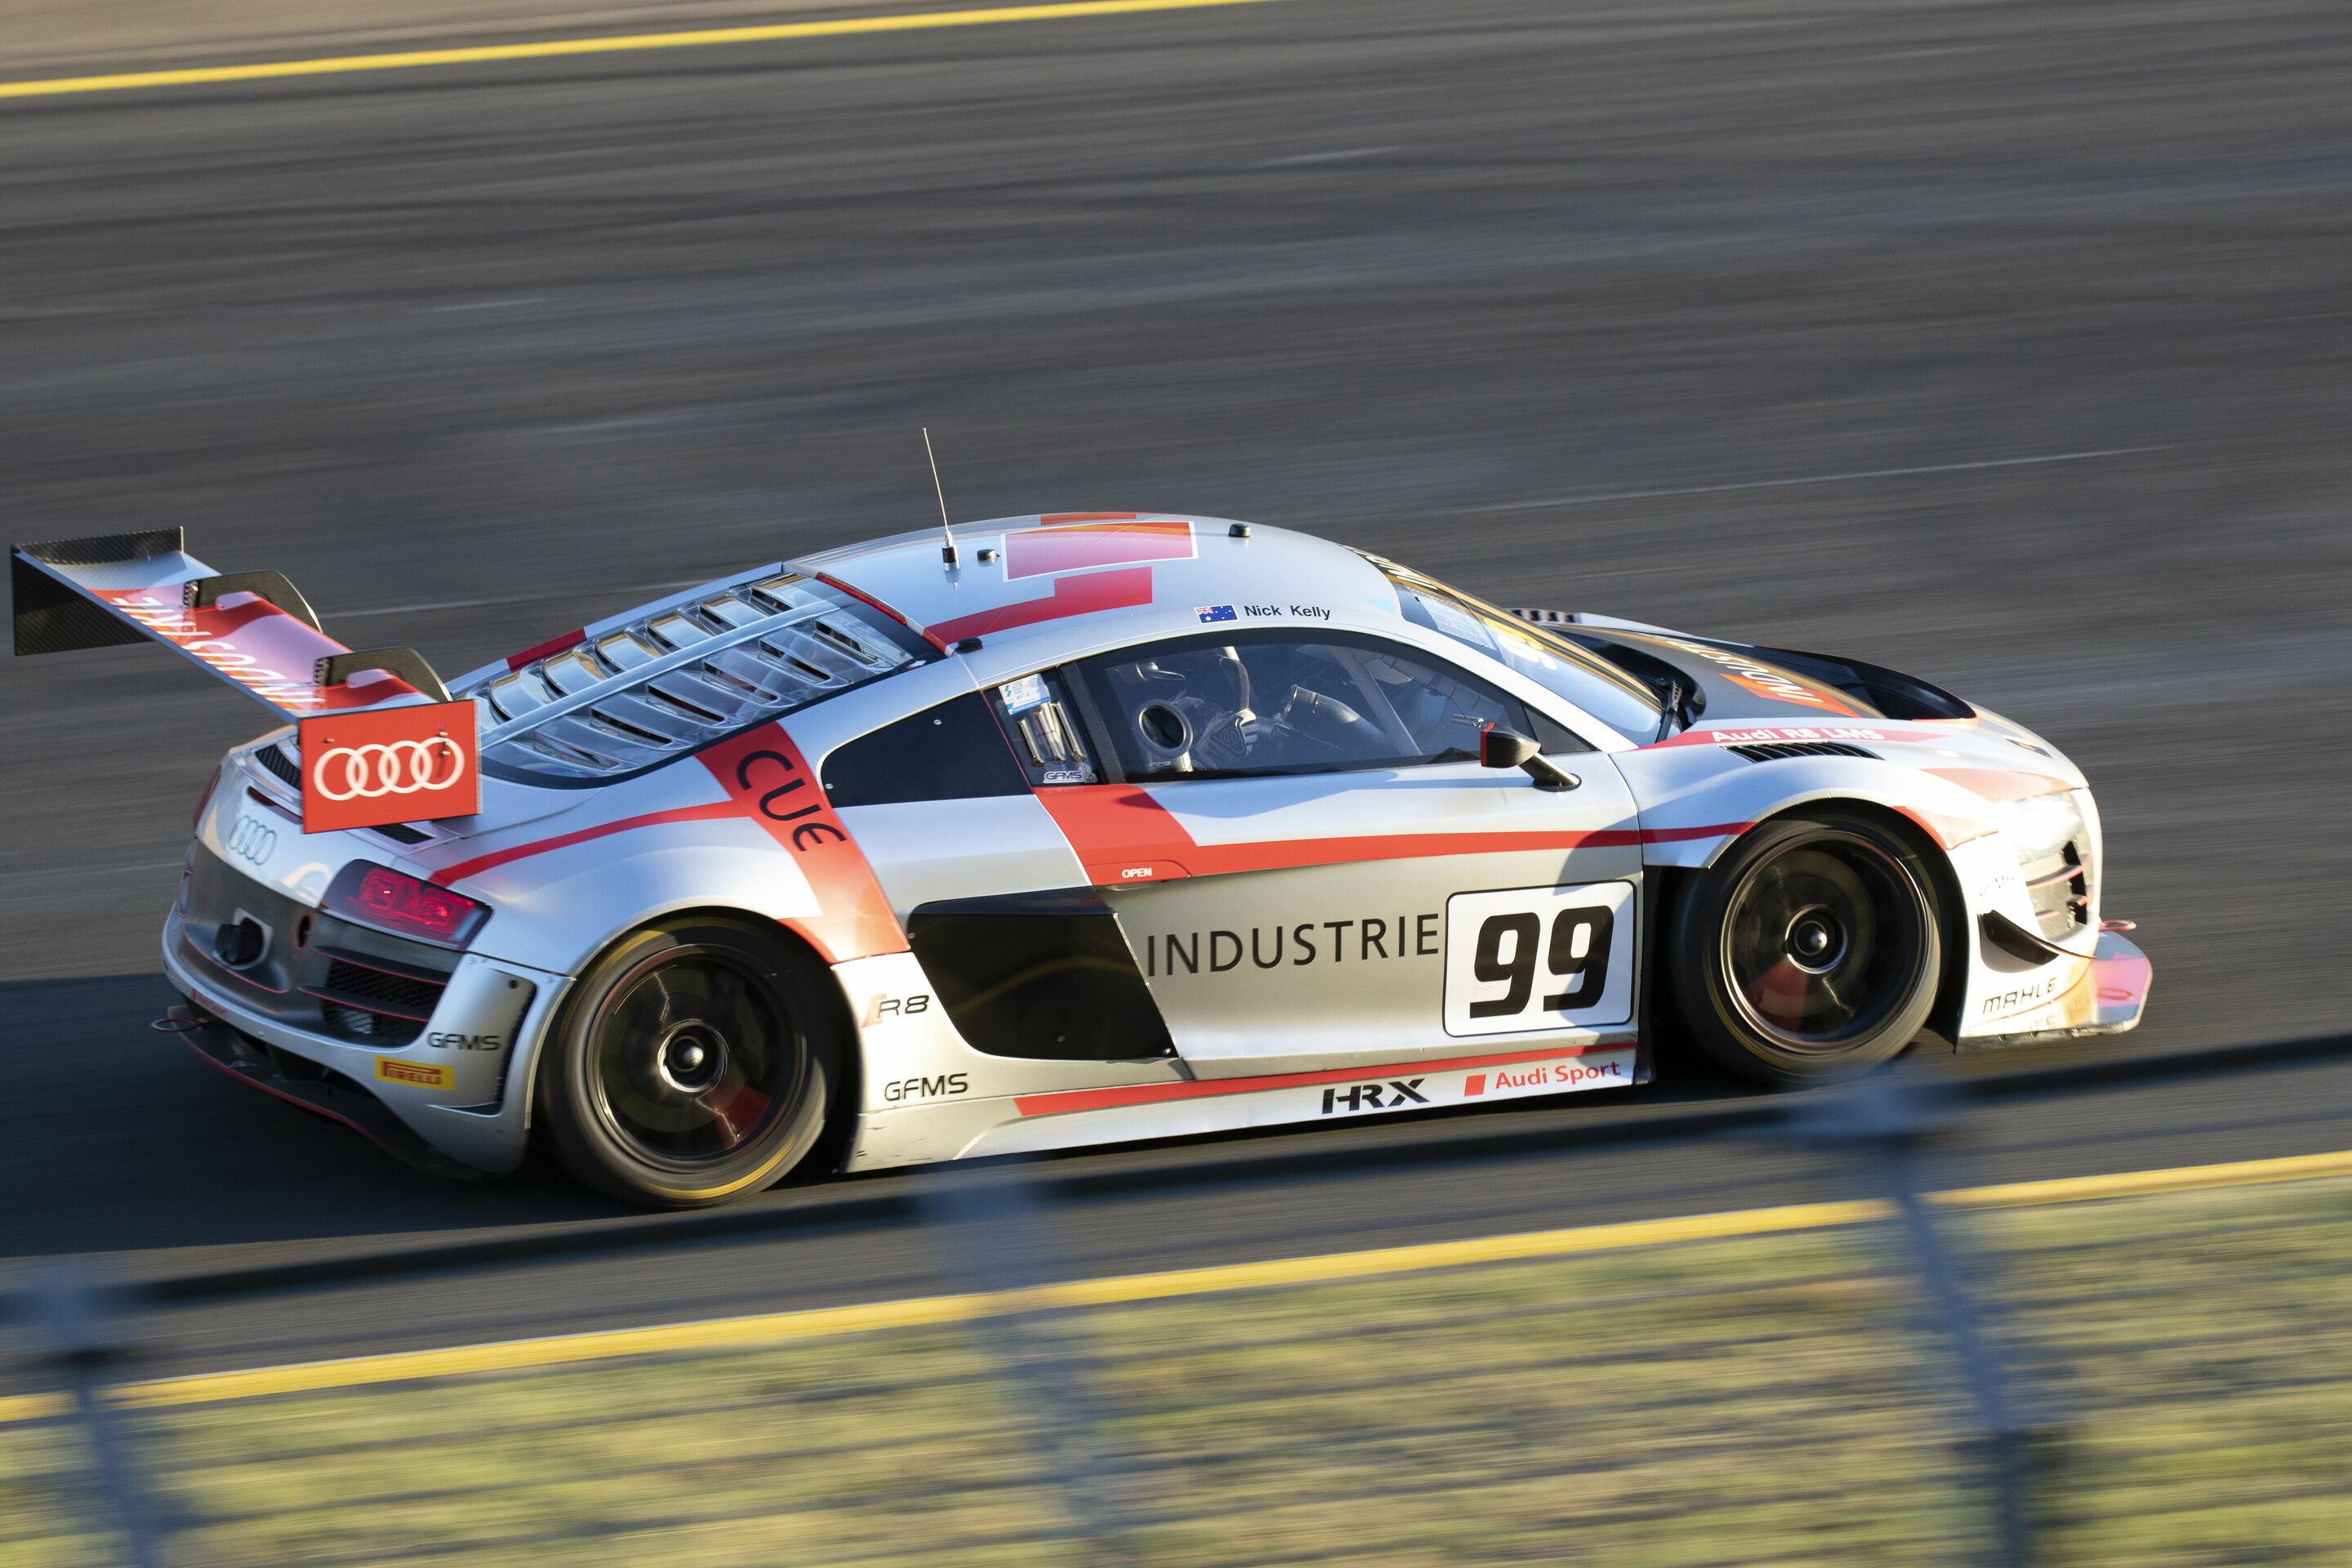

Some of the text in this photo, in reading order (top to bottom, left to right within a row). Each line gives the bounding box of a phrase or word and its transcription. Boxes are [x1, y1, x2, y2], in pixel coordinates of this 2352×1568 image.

[1244, 605, 1330, 621] Nick Kelly
[1712, 728, 1885, 742] Audi R8 LMS
[1046, 771, 1083, 780] GFMS
[737, 750, 847, 852] CUE
[1121, 867, 1152, 879] OPEN
[1147, 913, 1440, 978] INDUSTRIE
[1469, 905, 1615, 1019] 99
[877, 995, 930, 1019] R8
[1982, 977, 2058, 1015] MAHLE
[427, 1031, 501, 1052] GFMS
[381, 1061, 442, 1085] PIRELLI
[1495, 1061, 1621, 1090] Audi Sport
[884, 1072, 969, 1102] GFMS
[1321, 1077, 1431, 1115] HRX
